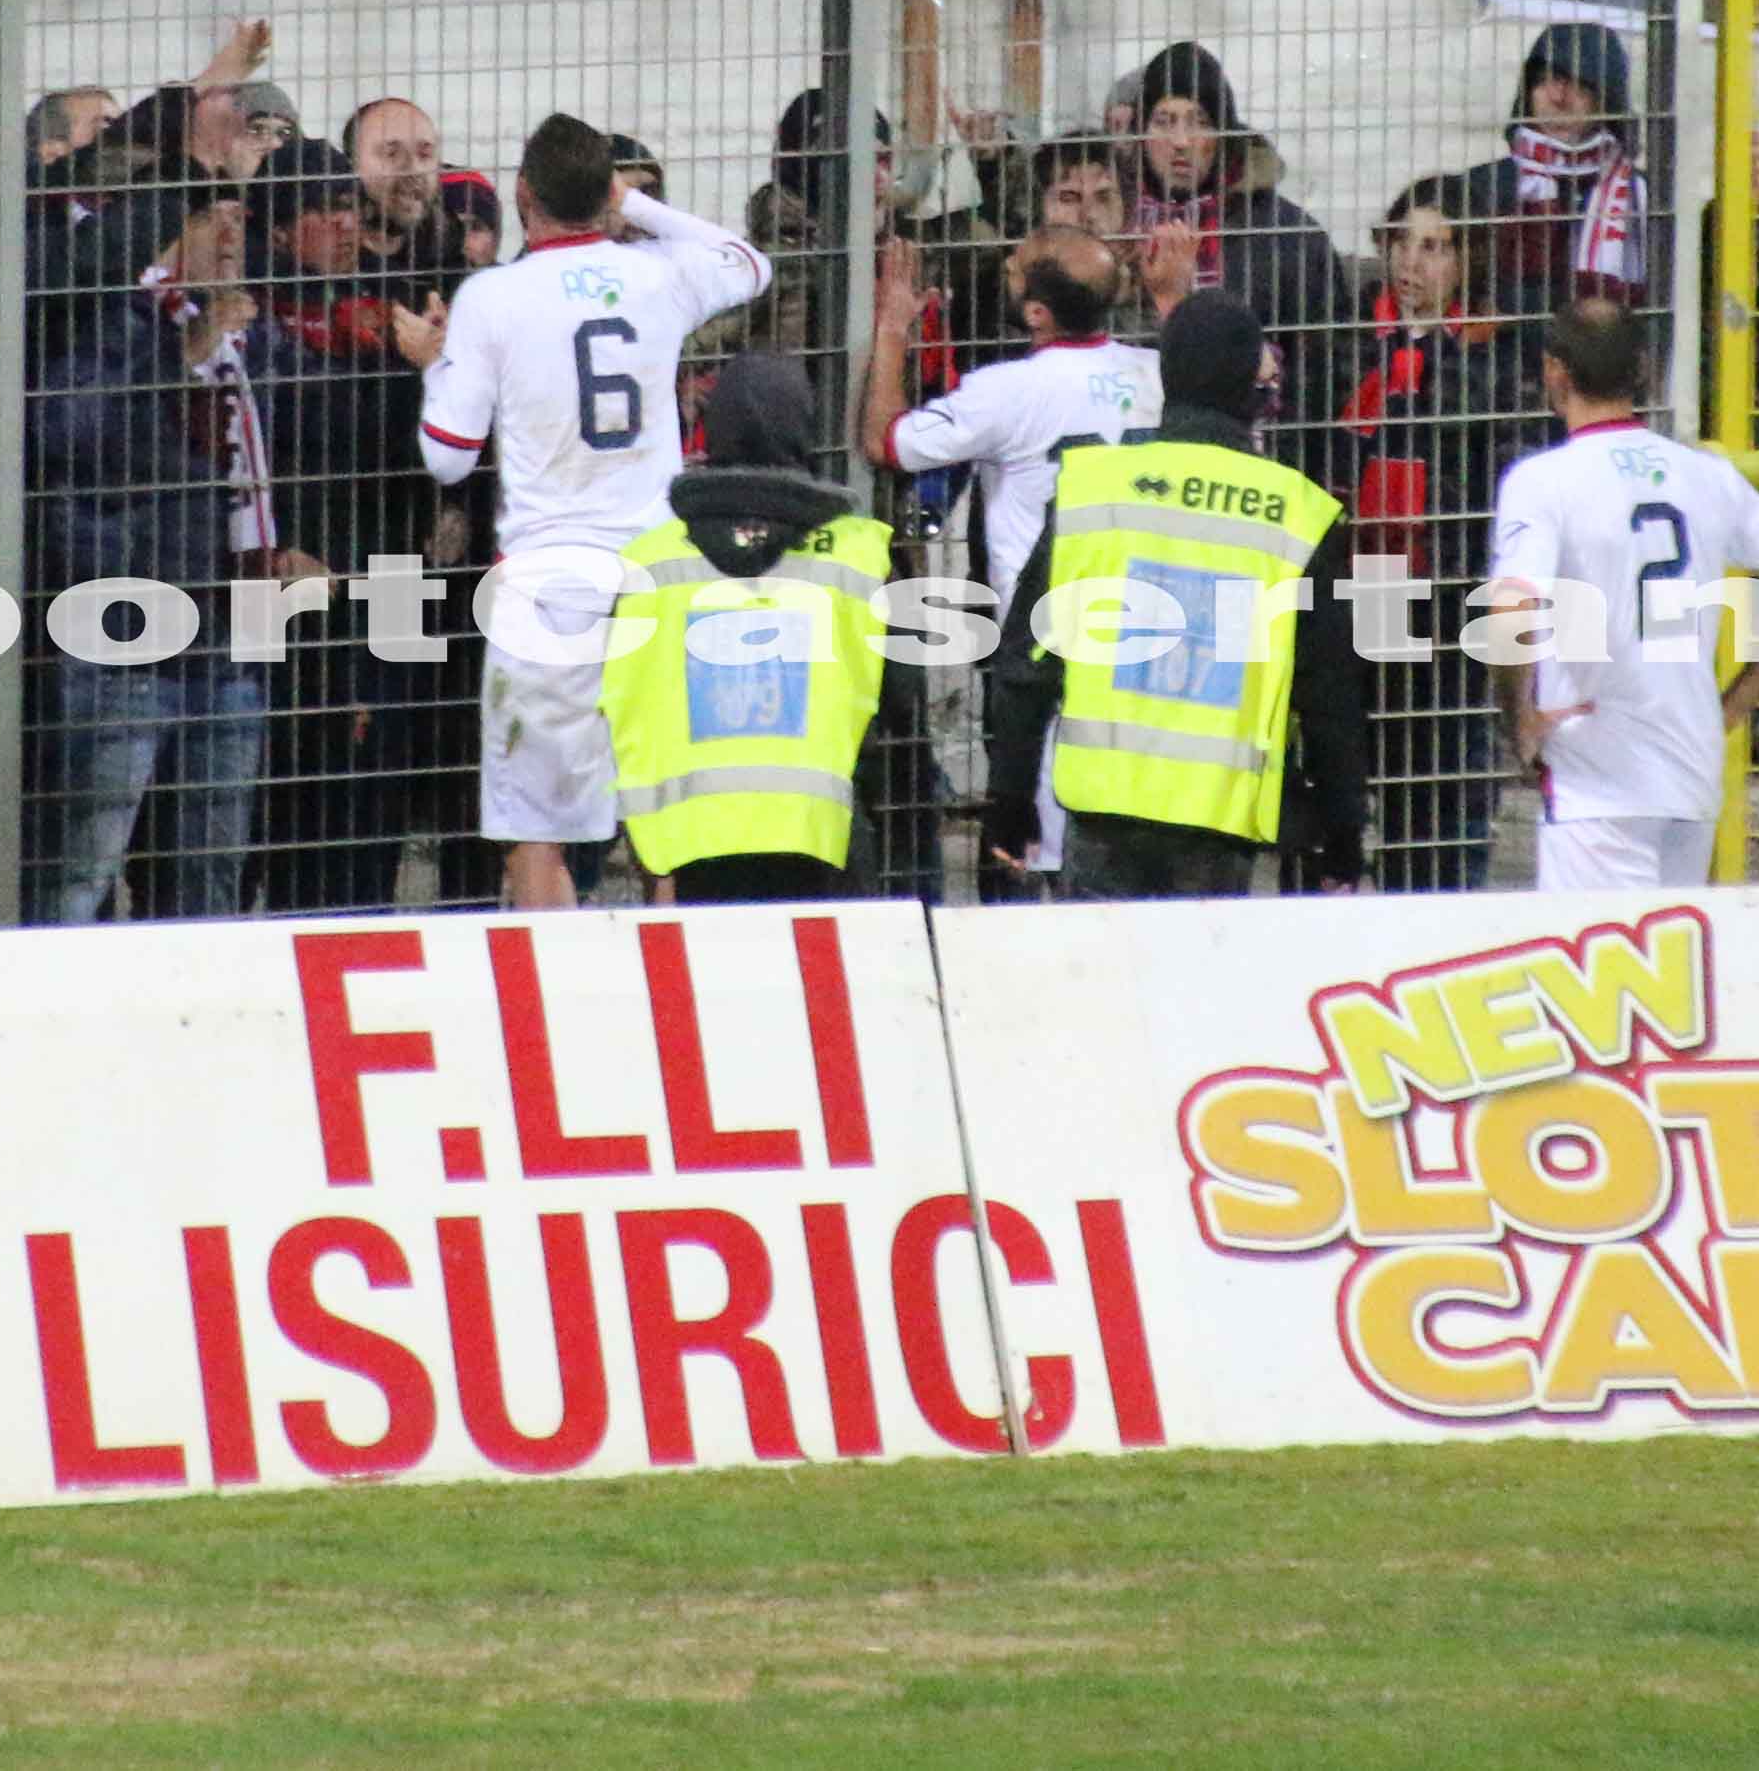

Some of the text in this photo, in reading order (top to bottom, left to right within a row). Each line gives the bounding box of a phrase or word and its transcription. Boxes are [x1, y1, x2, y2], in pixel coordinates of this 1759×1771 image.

[573, 315, 643, 443] 6
[1180, 475, 1288, 525] errea
[1628, 501, 1694, 644] 2
[293, 915, 876, 1187] F.LLI
[1312, 906, 1714, 1118] NEW
[24, 1192, 1167, 1493] LISURICI
